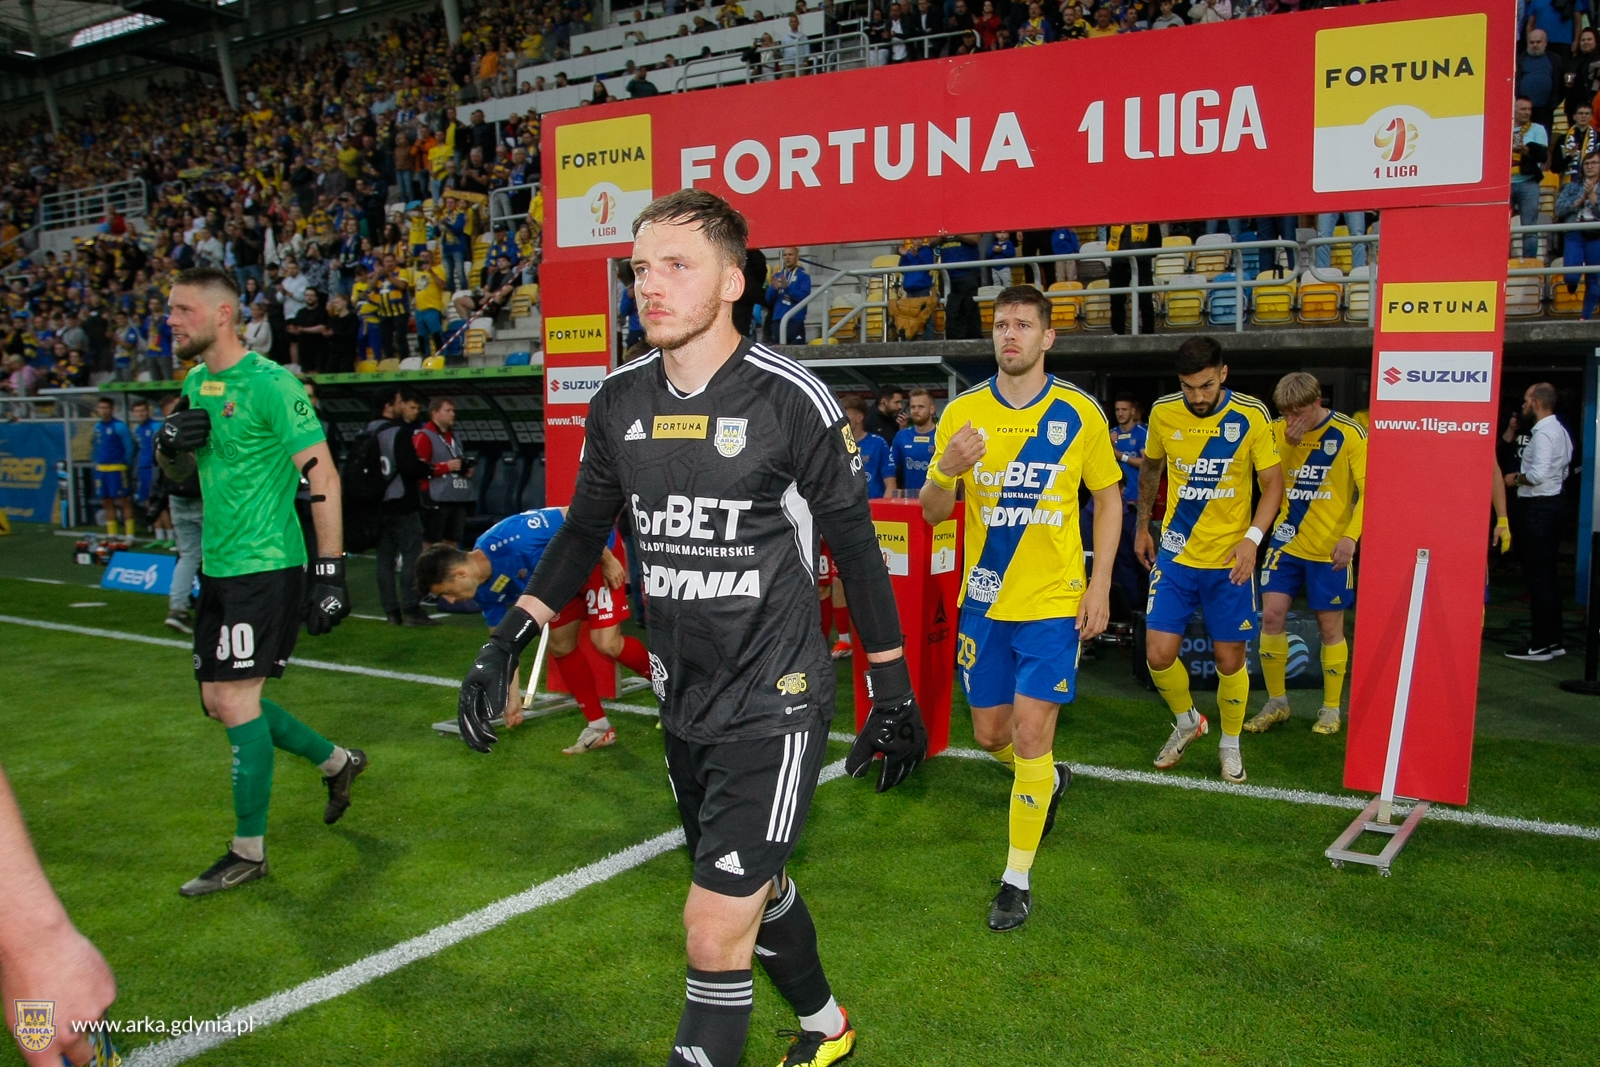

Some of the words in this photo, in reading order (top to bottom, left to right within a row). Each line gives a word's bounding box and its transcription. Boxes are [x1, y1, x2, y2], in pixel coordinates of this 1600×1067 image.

[1325, 56, 1475, 89] FORTUNA
[680, 111, 1035, 195] FORTUNA
[1077, 100, 1104, 164] 1
[1123, 85, 1268, 160] LIGA
[560, 146, 646, 170] FORTUNA
[1373, 167, 1380, 179] 1
[1386, 165, 1418, 178] LIGA
[591, 228, 596, 238] 1
[598, 226, 617, 237] LIGA
[1388, 300, 1489, 314] FORTUNA
[549, 329, 602, 340] FORTUNA
[562, 380, 601, 390] SUZUK
[1406, 370, 1488, 384] SUZUKI
[547, 416, 586, 427] www.1lig
[656, 422, 702, 431] FORTUNA
[1374, 417, 1490, 435] www.1liga.org
[624, 432, 647, 441] adidas
[1175, 457, 1235, 475] forBET
[1288, 464, 1332, 480] orBET
[972, 461, 1067, 490] forBET
[1177, 484, 1236, 501] GDYNIA
[631, 493, 753, 541] forBET
[980, 505, 1064, 527] GDYNIA
[877, 533, 906, 543] RTUNA
[933, 532, 955, 542] FORTUNA
[665, 543, 755, 557] BUKMACHERSKIE
[642, 561, 761, 601] GDYNIA
[586, 586, 614, 615] 24
[215, 622, 255, 661] 30
[232, 659, 255, 669] JAKO
[714, 860, 745, 876] adidas
